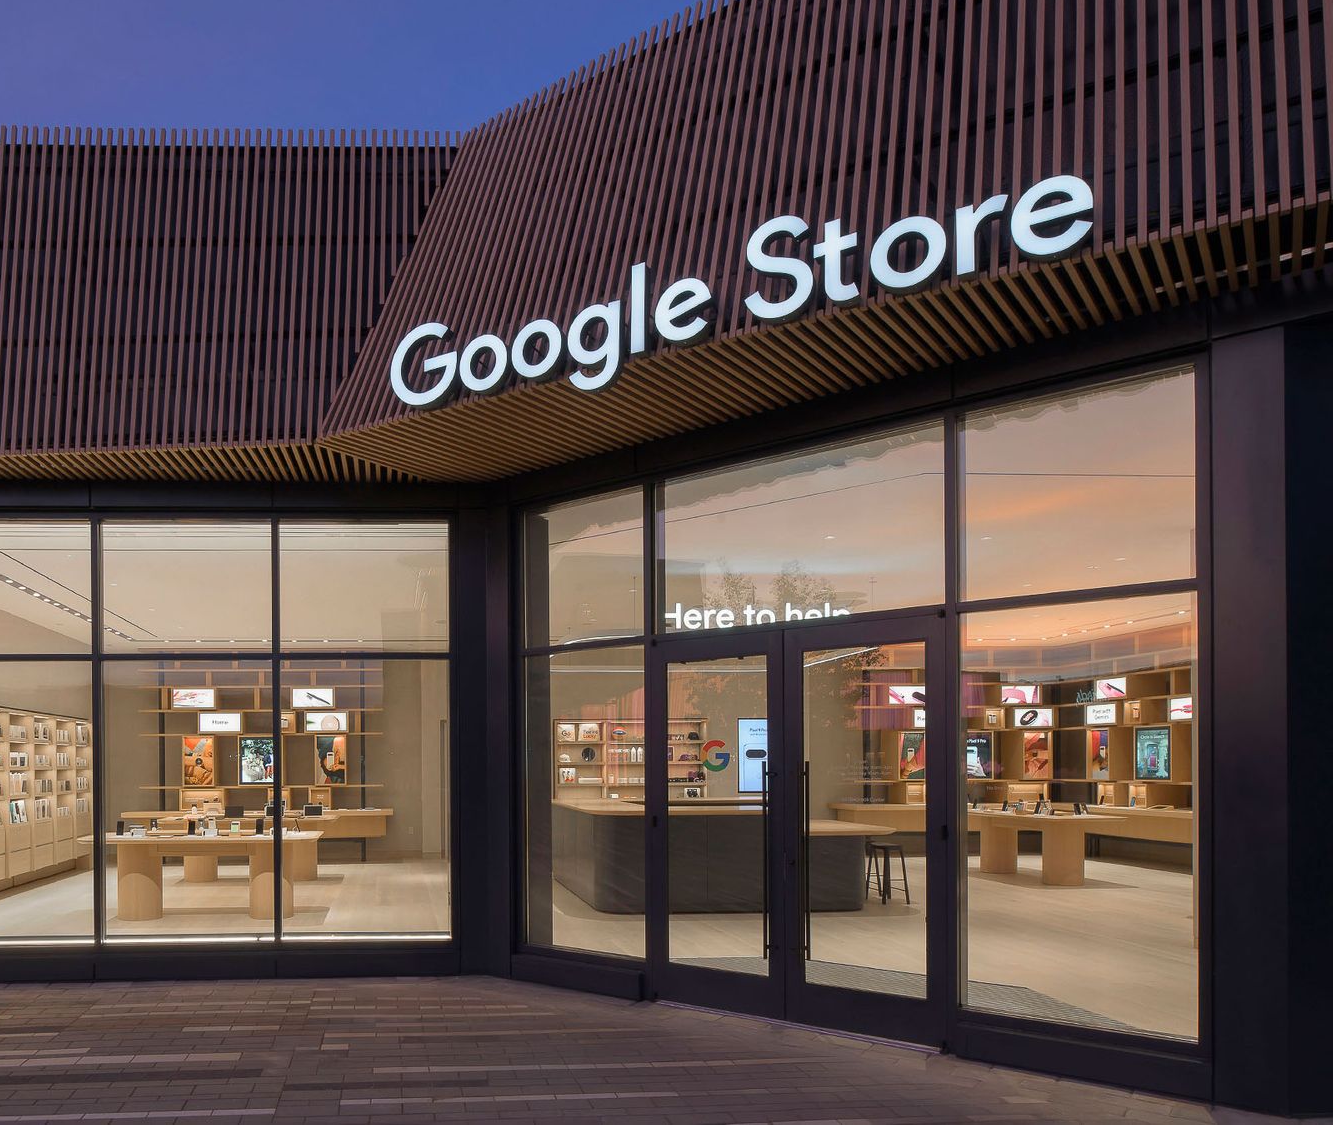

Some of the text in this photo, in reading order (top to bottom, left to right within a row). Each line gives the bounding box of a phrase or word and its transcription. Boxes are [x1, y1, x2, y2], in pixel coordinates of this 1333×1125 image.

[390, 174, 1095, 407] Google Store
[665, 603, 851, 630] Here to hel
[700, 740, 730, 772] G
